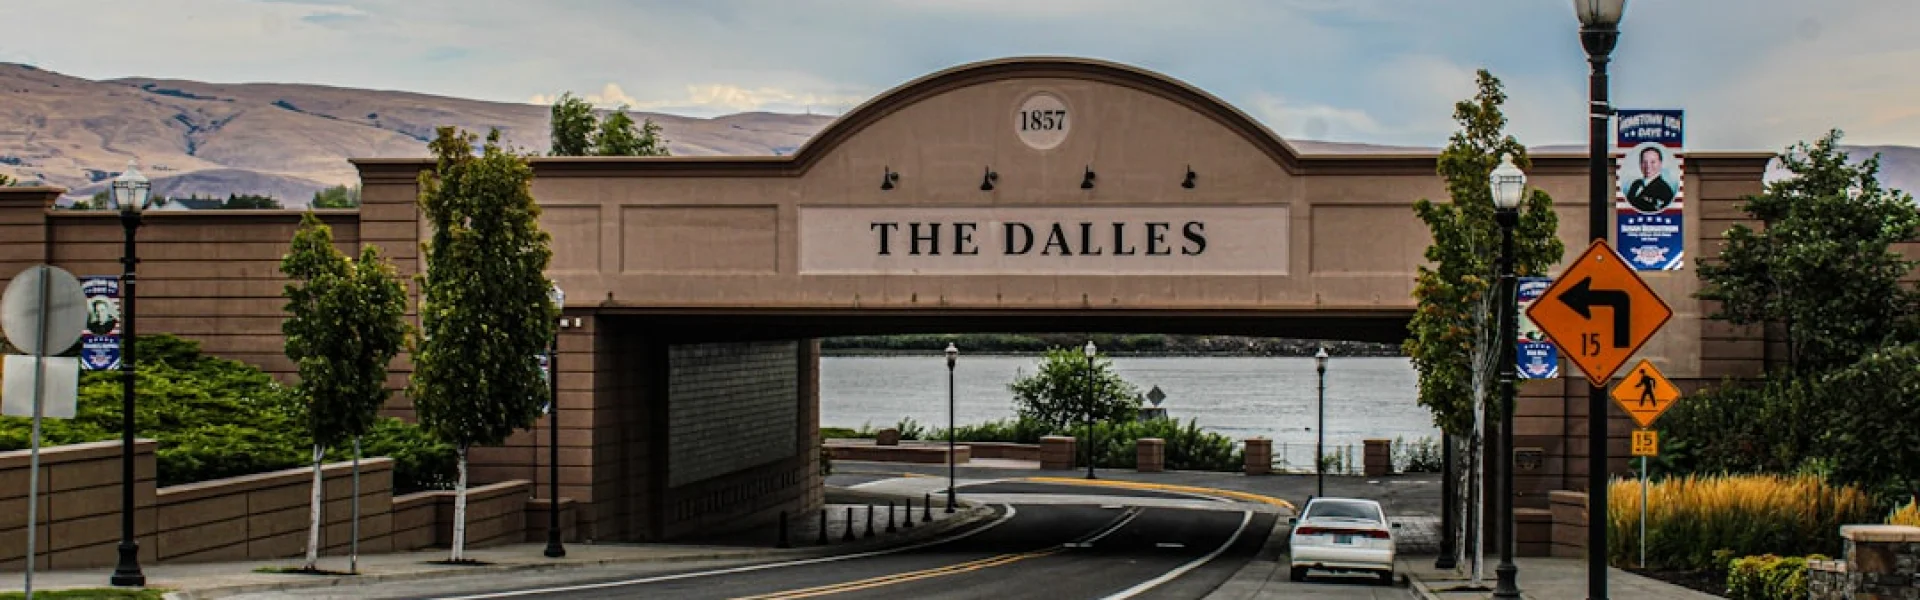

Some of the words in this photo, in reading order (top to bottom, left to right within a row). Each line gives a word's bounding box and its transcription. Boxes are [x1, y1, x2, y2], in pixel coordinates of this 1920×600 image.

[1020, 109, 1066, 131] 1857
[870, 222, 979, 256] THE
[1003, 221, 1207, 257] DALLES
[1581, 332, 1601, 358] 15
[1636, 433, 1653, 446] 15
